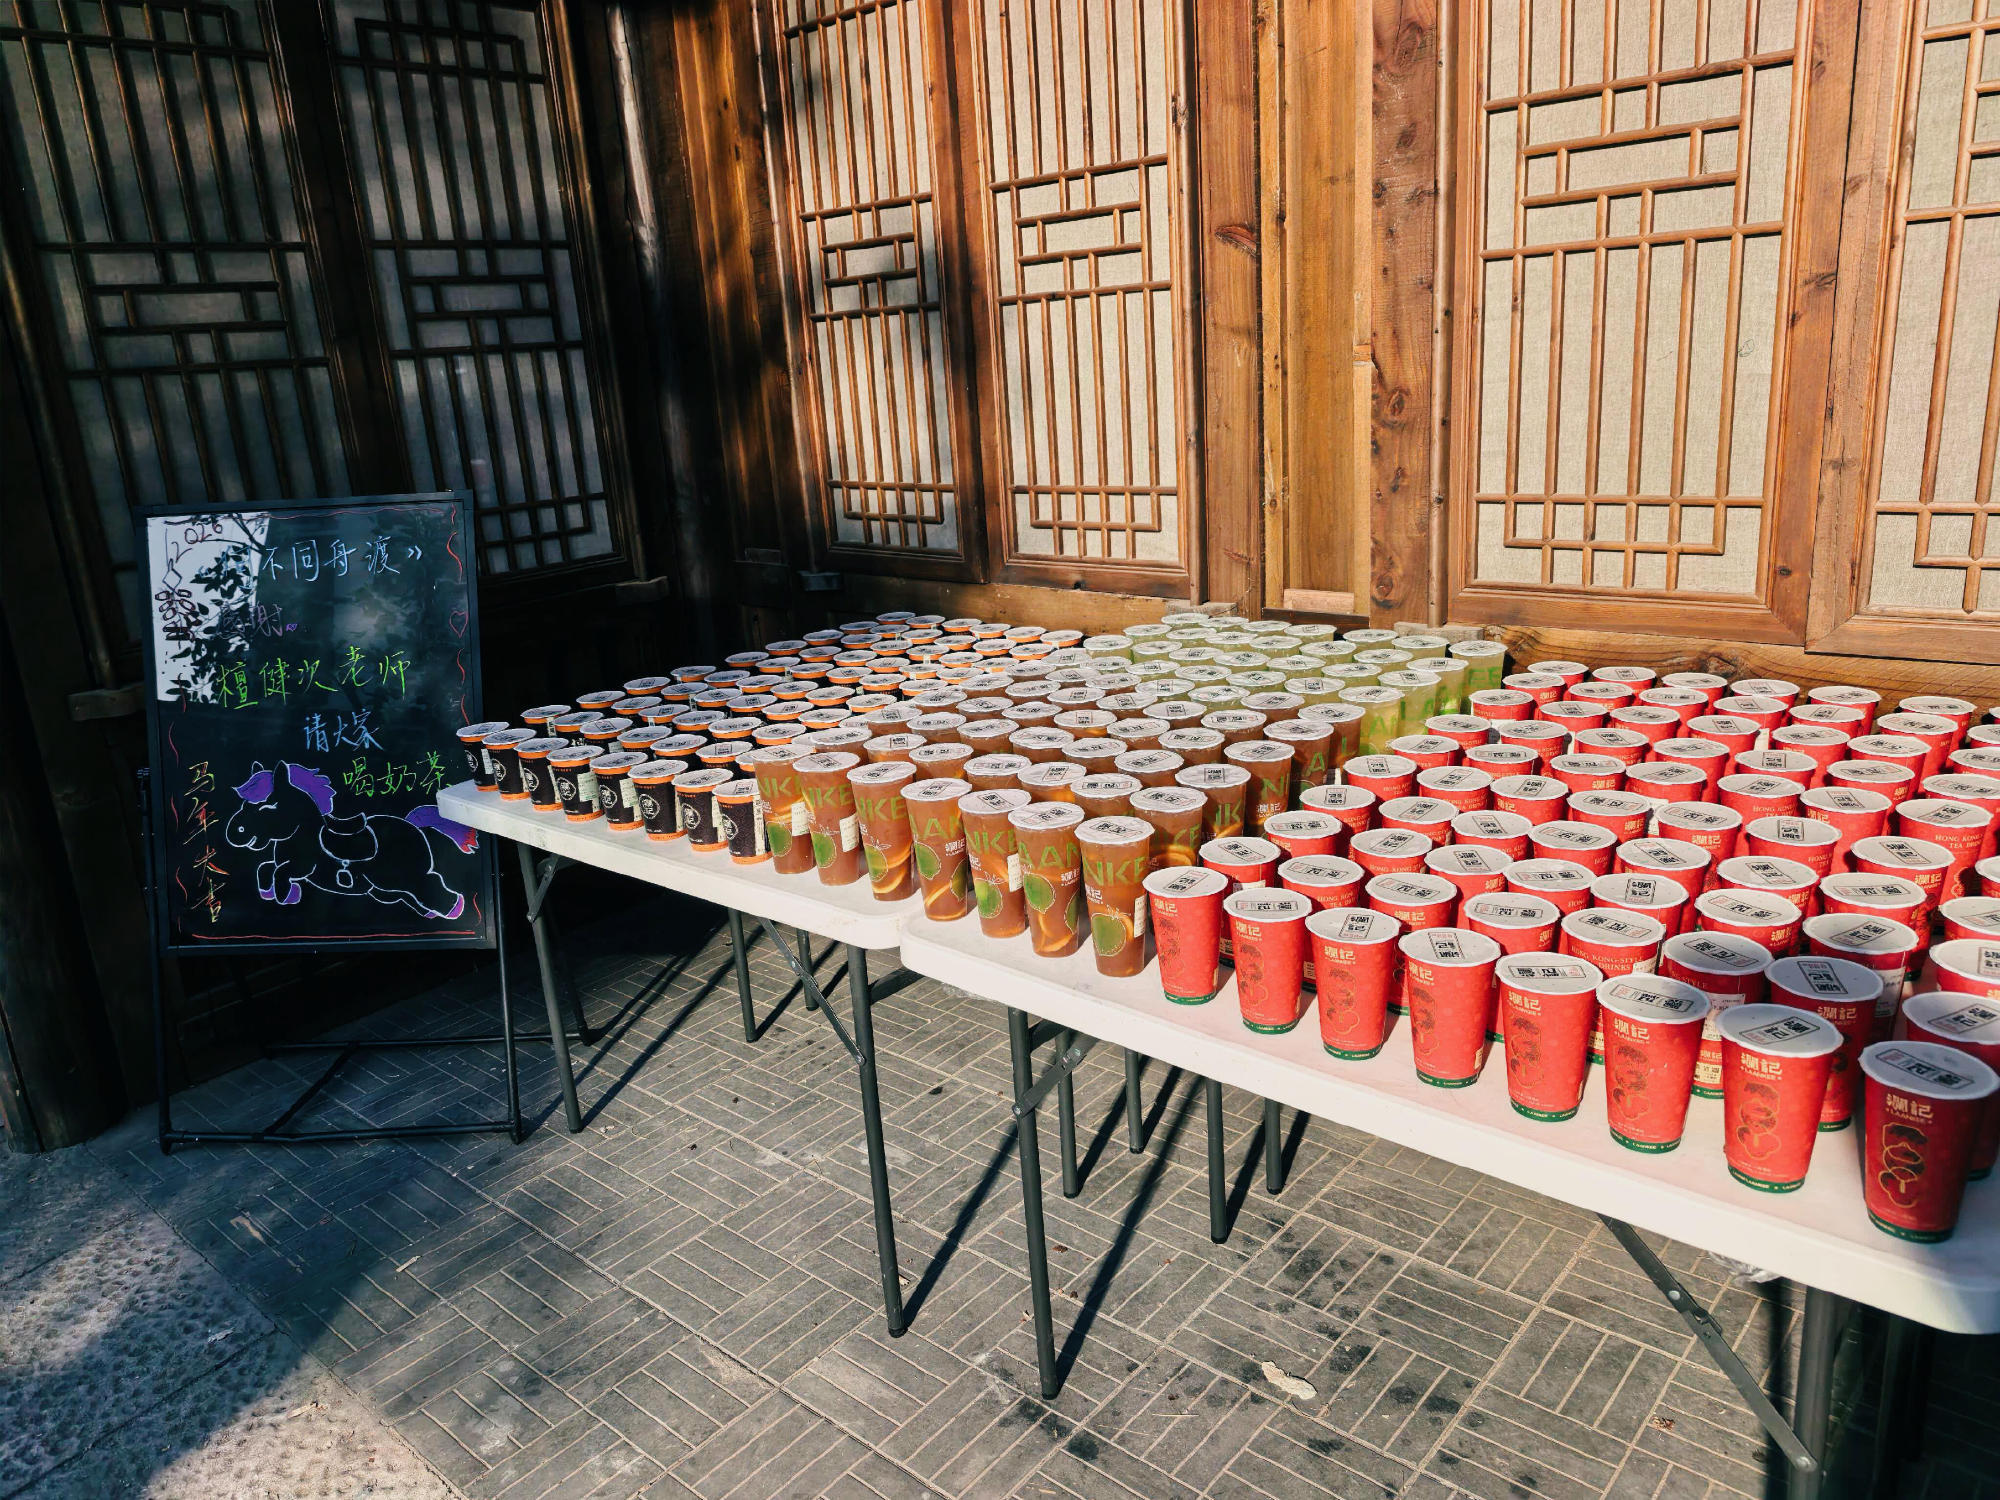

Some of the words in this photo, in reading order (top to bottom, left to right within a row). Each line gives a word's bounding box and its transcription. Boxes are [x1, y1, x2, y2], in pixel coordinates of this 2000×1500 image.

[304, 708, 384, 752] 请大家
[343, 750, 450, 797] 喝奶茶
[1741, 1052, 1782, 1074] 瀾記
[1886, 1093, 1934, 1119] 瀾記
